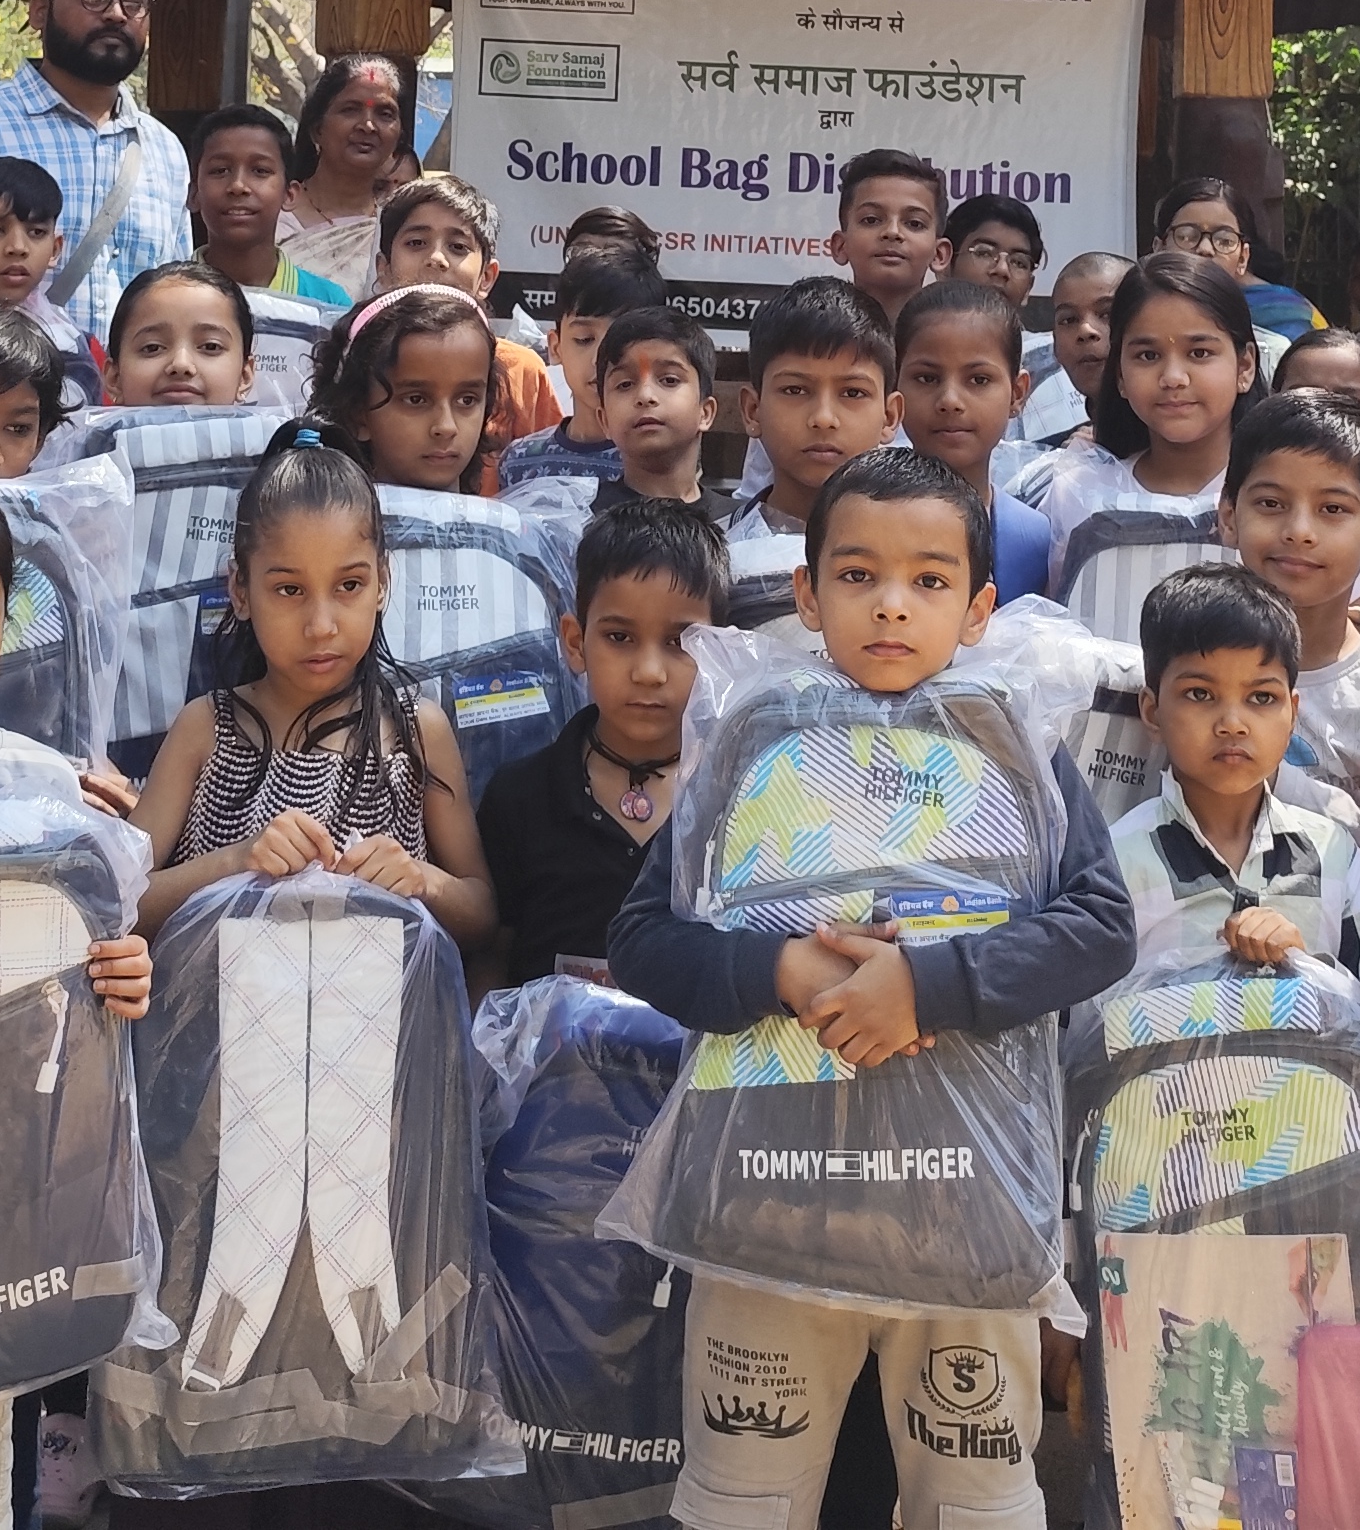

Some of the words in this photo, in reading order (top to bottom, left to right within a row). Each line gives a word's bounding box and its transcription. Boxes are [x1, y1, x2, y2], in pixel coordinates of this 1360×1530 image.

[555, 0, 585, 7] ALWAYS
[796, 7, 816, 29] के
[821, 8, 882, 31] सौजन्य
[887, 11, 904, 34] से
[527, 50, 558, 62] Sarv
[562, 52, 605, 68] Samaj
[526, 64, 606, 80] Foundation
[677, 50, 739, 93] सर्व
[749, 64, 857, 97] समाज
[863, 58, 1026, 106] फाउंडेशन
[818, 110, 854, 129] द्वारा
[507, 139, 661, 187] School
[680, 147, 770, 201] Bag
[703, 234, 833, 257] INITIATIVES
[254, 354, 287, 364] OMMY
[255, 364, 288, 373] LFIGER
[190, 515, 235, 531] TOMM
[186, 528, 236, 544] HILFIGE
[419, 584, 477, 598] TOMMY
[417, 598, 479, 611] HILFIGER
[1095, 749, 1147, 770] TOMMY
[870, 765, 944, 790] TOMMY
[1088, 763, 1146, 786] HILFIGER
[865, 783, 945, 808] HILFIGER
[1181, 1107, 1249, 1127] TOMMY
[739, 1149, 823, 1180] TOMMY
[862, 1146, 976, 1181] HILFIGER
[1101, 1265, 1121, 1286] 2
[706, 1336, 725, 1352] THE
[727, 1344, 790, 1362] BROOKLYN
[707, 1350, 750, 1372] FASHION
[754, 1364, 787, 1375] 2010
[709, 1363, 730, 1381] 1111
[733, 1374, 757, 1386] ART
[761, 1376, 808, 1387] STREET
[952, 1359, 976, 1393] S
[774, 1387, 808, 1400] YORK
[1229, 1378, 1250, 1439] Activity
[583, 1432, 682, 1465] HILFIGER
[936, 1418, 1023, 1466] King
